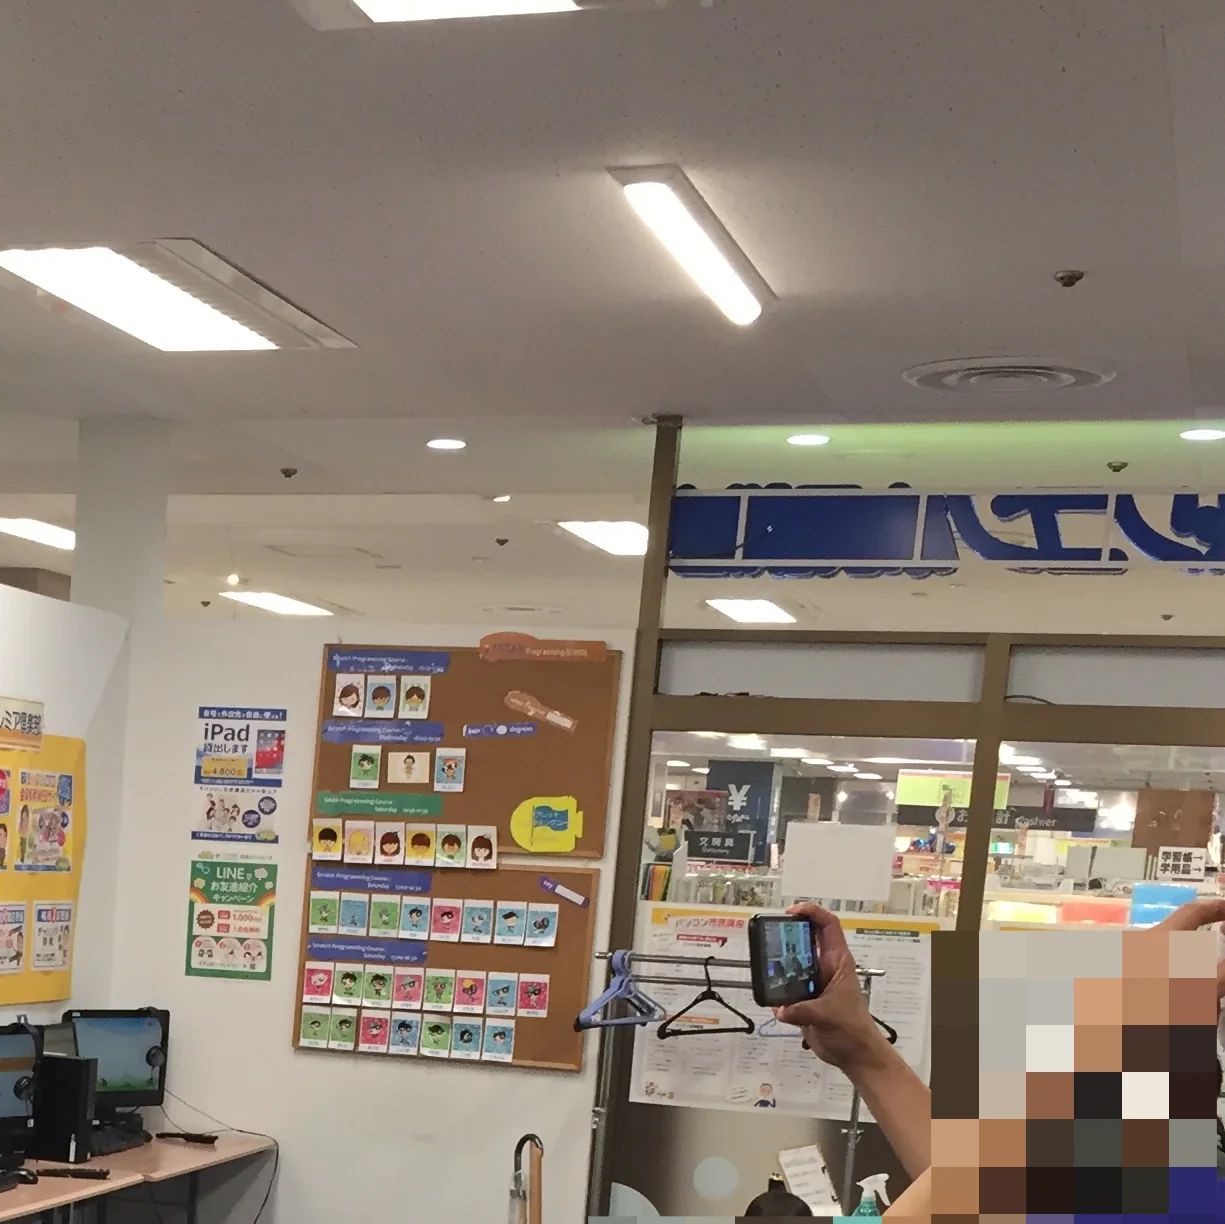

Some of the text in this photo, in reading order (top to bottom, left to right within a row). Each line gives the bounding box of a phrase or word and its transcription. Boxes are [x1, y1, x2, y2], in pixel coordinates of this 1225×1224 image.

[204, 722, 250, 742] iPad
[203, 743, 249, 754] 貸出します
[699, 837, 734, 847] 文房具
